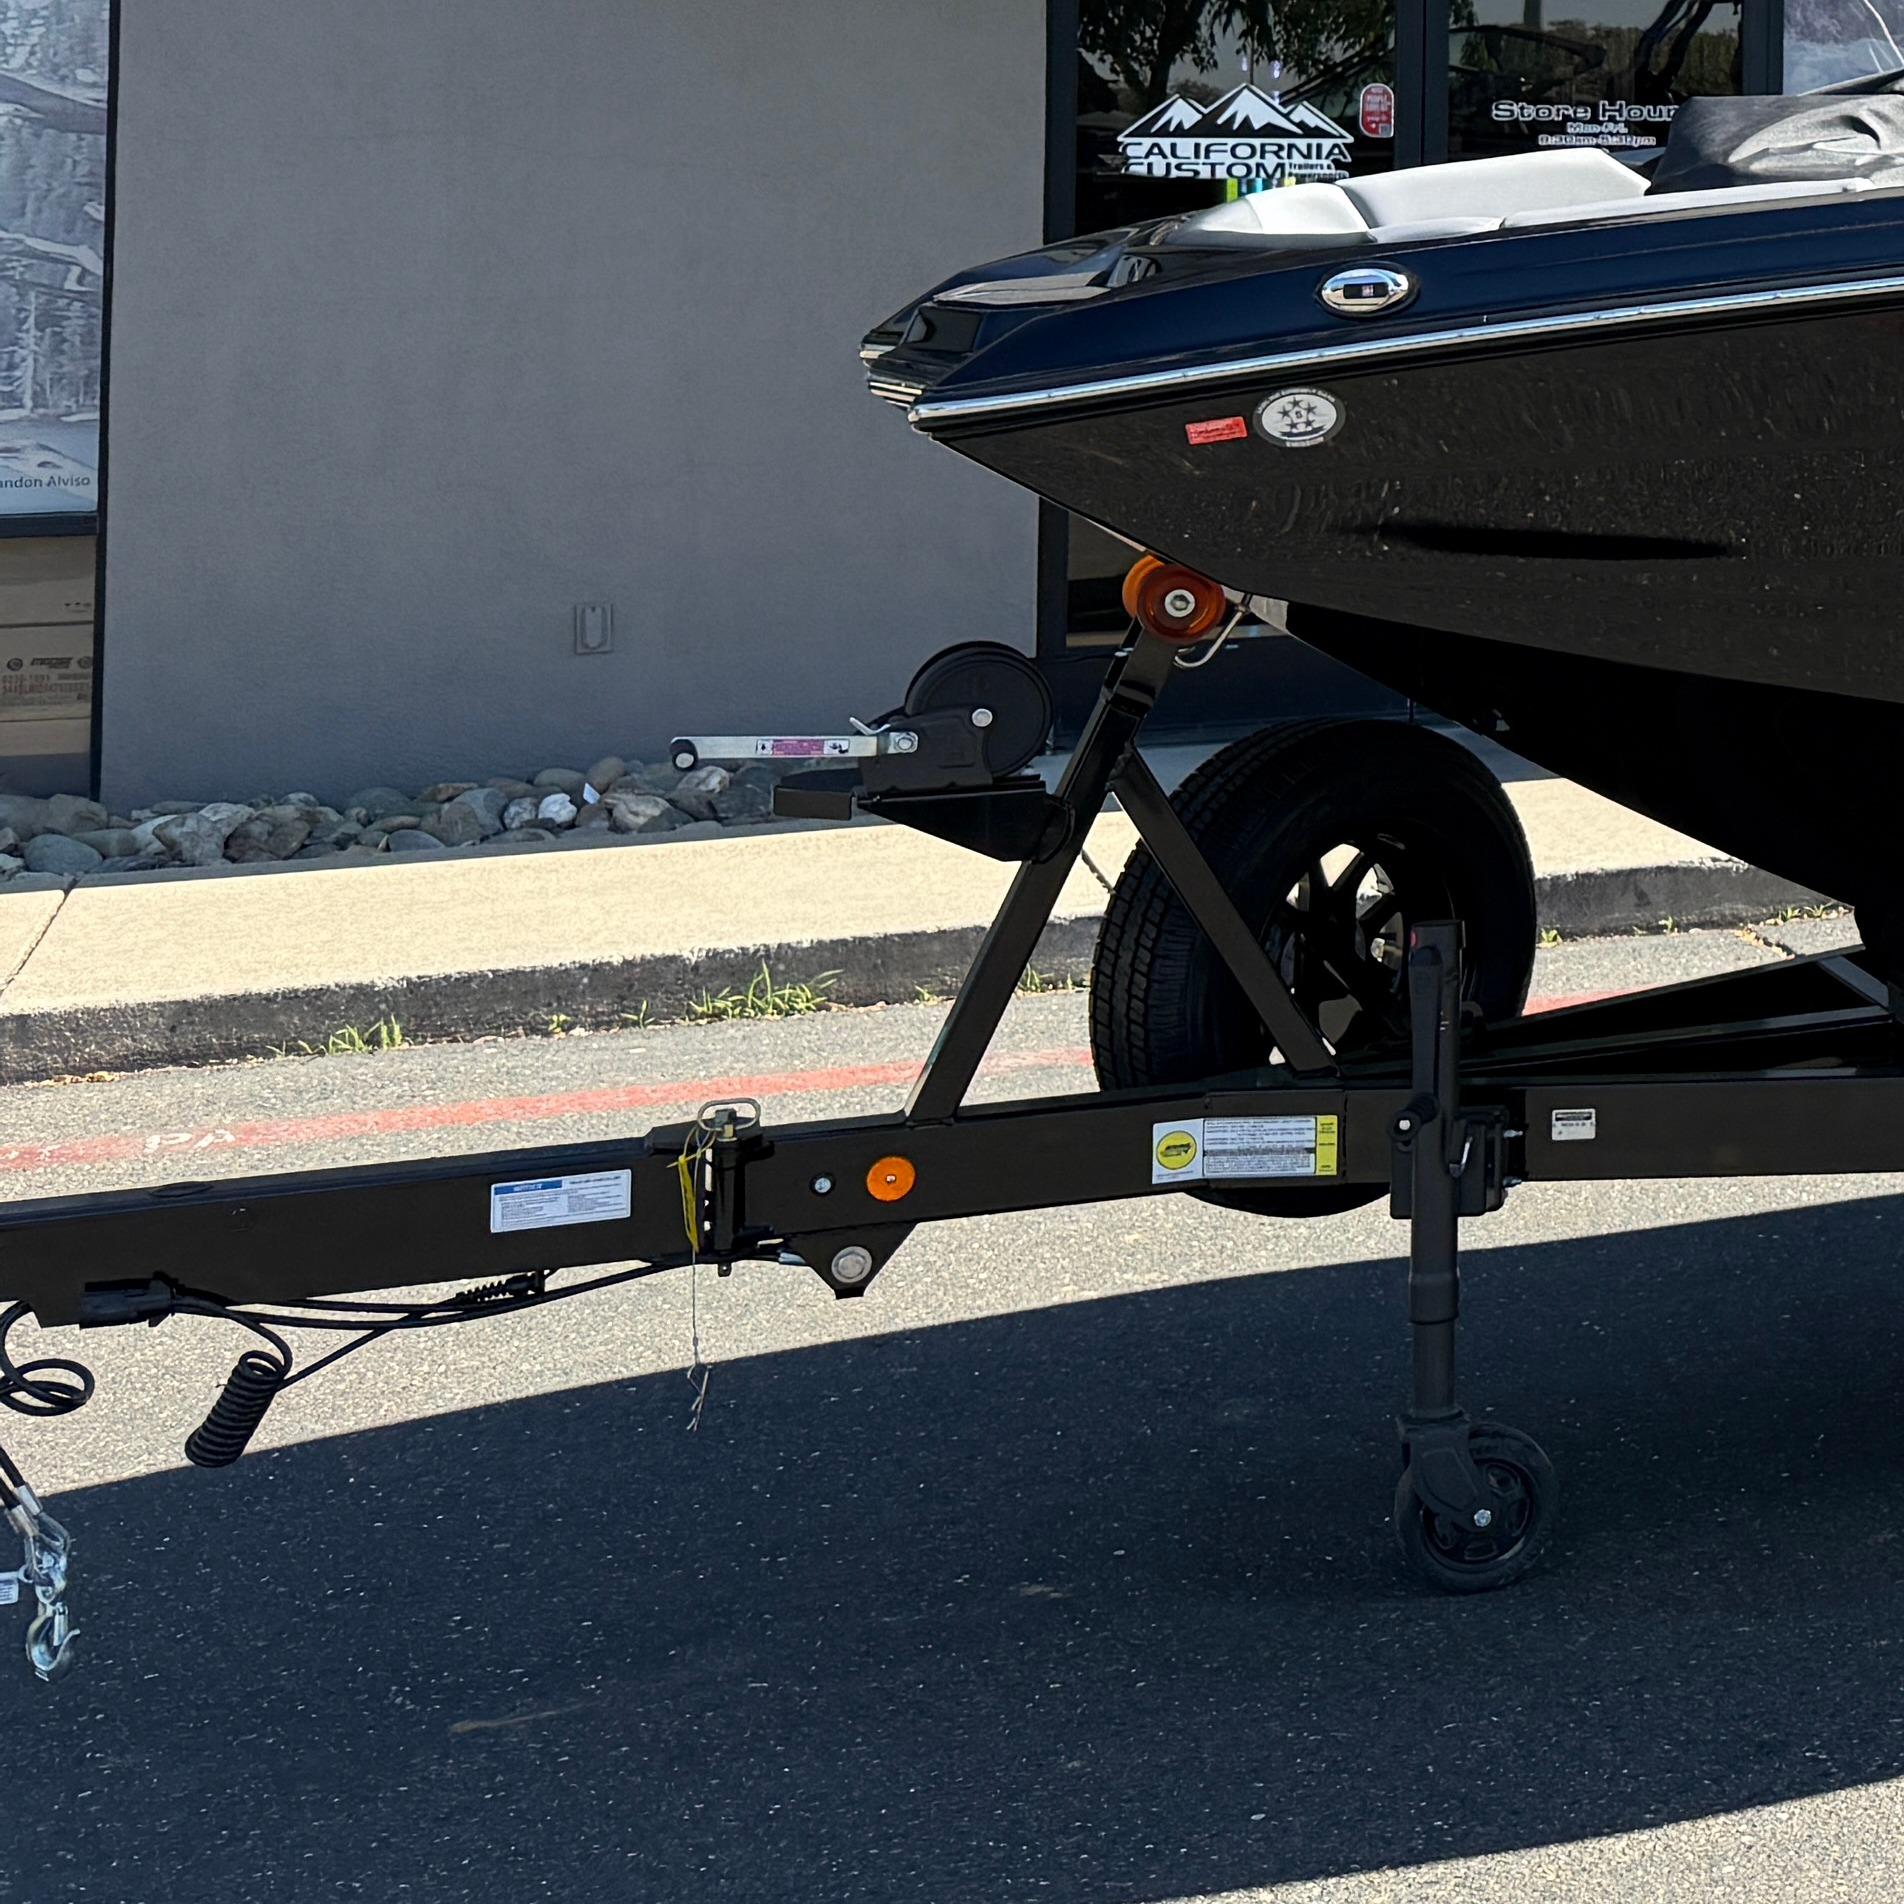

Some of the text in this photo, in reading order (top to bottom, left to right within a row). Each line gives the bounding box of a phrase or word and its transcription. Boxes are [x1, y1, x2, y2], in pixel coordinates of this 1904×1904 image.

[1491, 99, 1680, 122] Store Hour
[1123, 141, 1350, 161] CALIFORNIA
[1124, 161, 1286, 180] CUSTOM
[46, 475, 91, 488] Alviso
